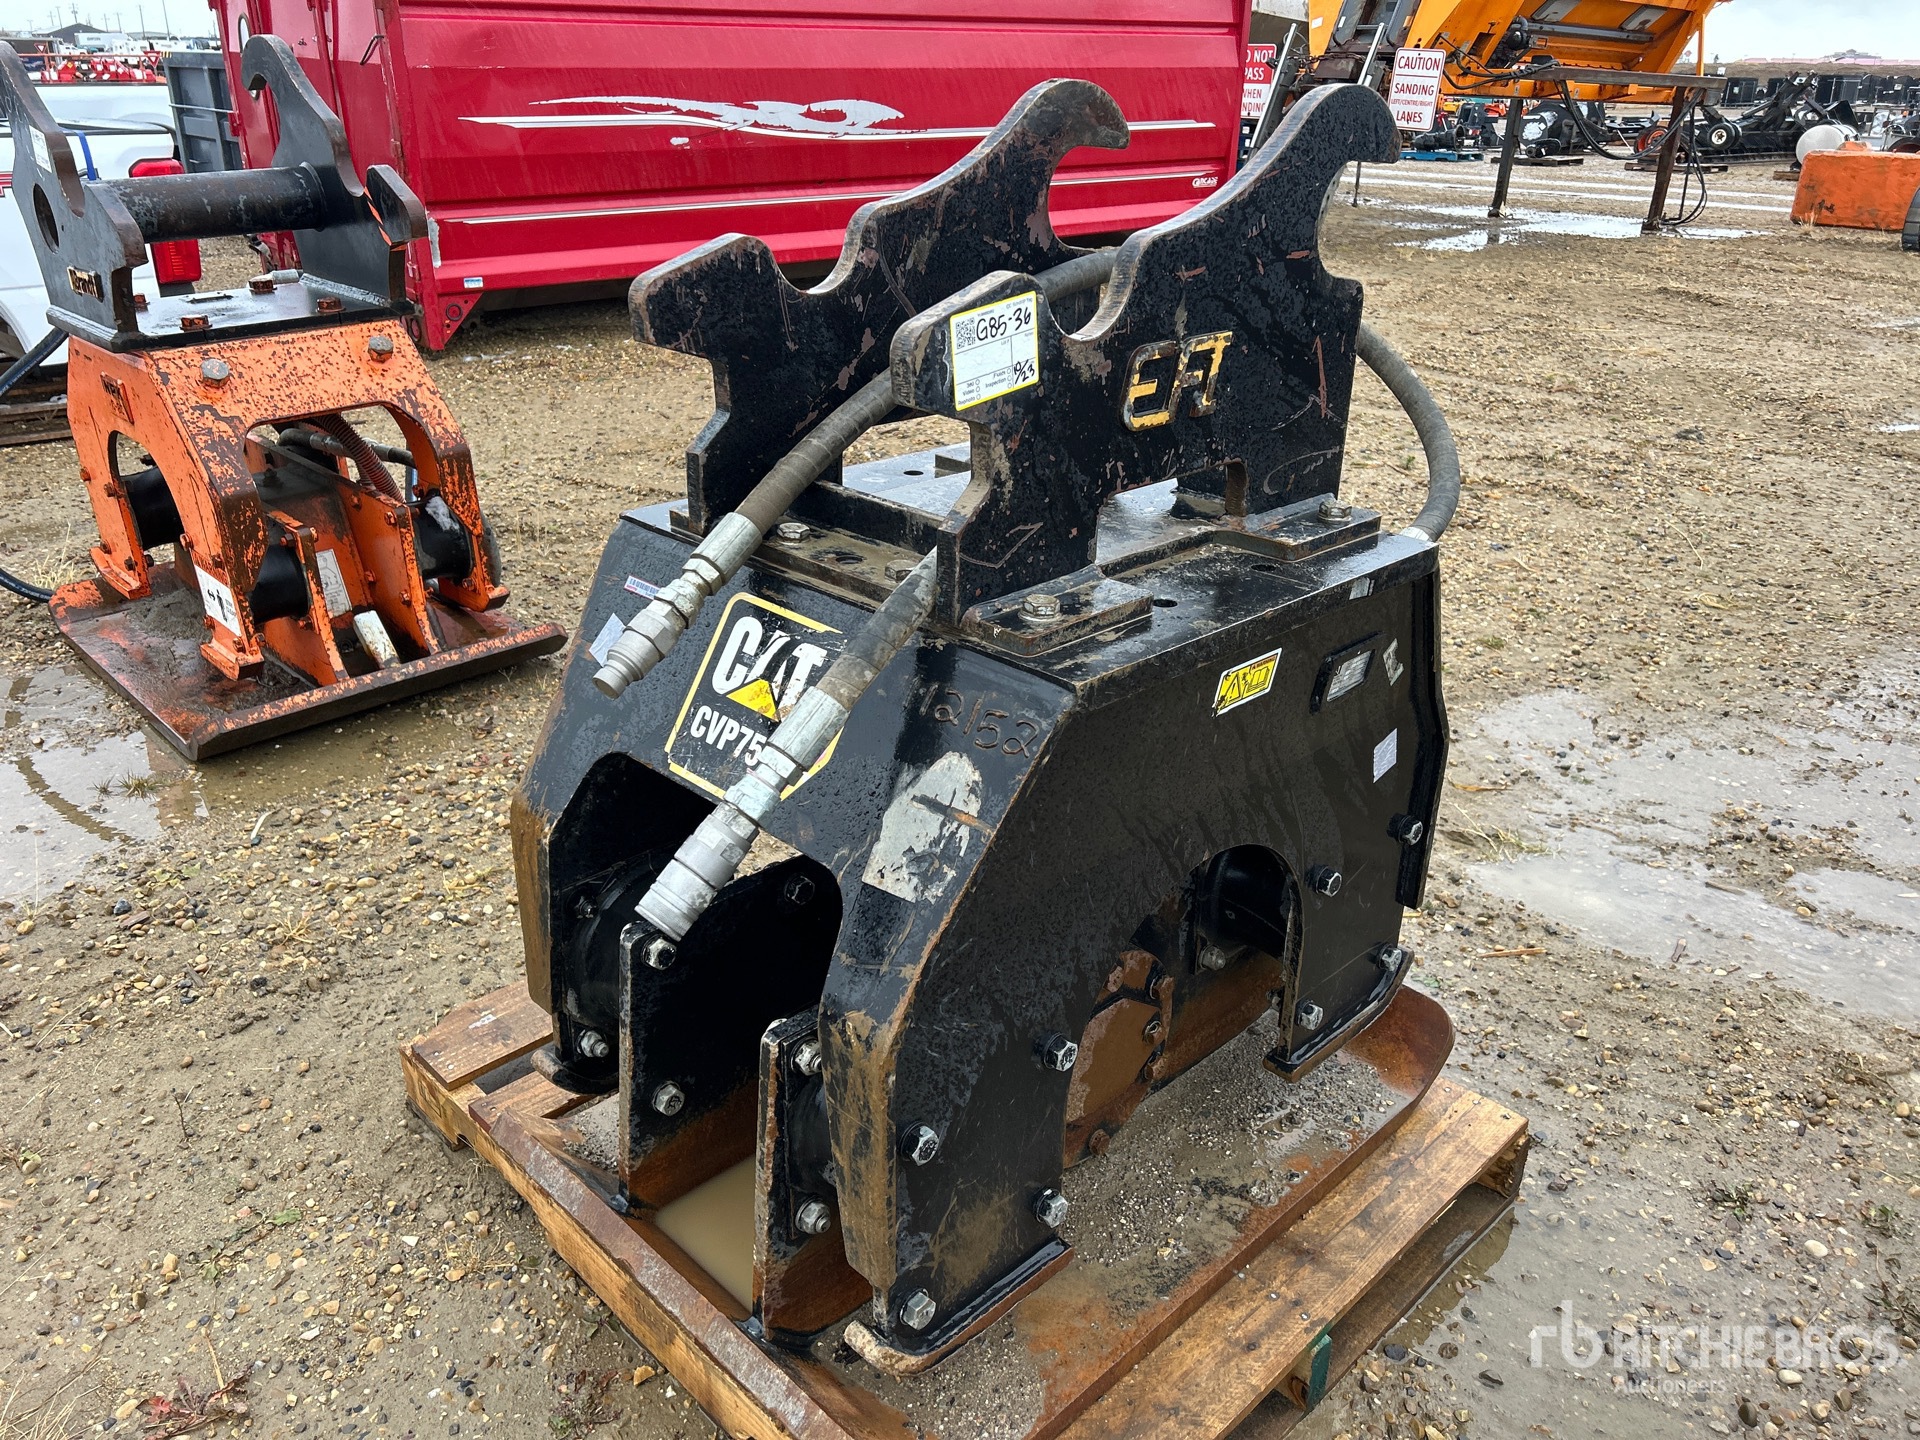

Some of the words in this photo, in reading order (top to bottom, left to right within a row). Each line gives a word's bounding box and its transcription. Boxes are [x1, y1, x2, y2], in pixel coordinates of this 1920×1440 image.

[1397, 56, 1441, 71] CAUTION
[1394, 83, 1434, 96] SANDING
[1391, 98, 1433, 107] LEFT/CENTRE/RIGHT
[1396, 110, 1423, 123] LANES
[976, 306, 1032, 341] G85-36
[711, 616, 828, 722] CAT
[919, 682, 1040, 759] 12152
[690, 705, 768, 767] CVP75
